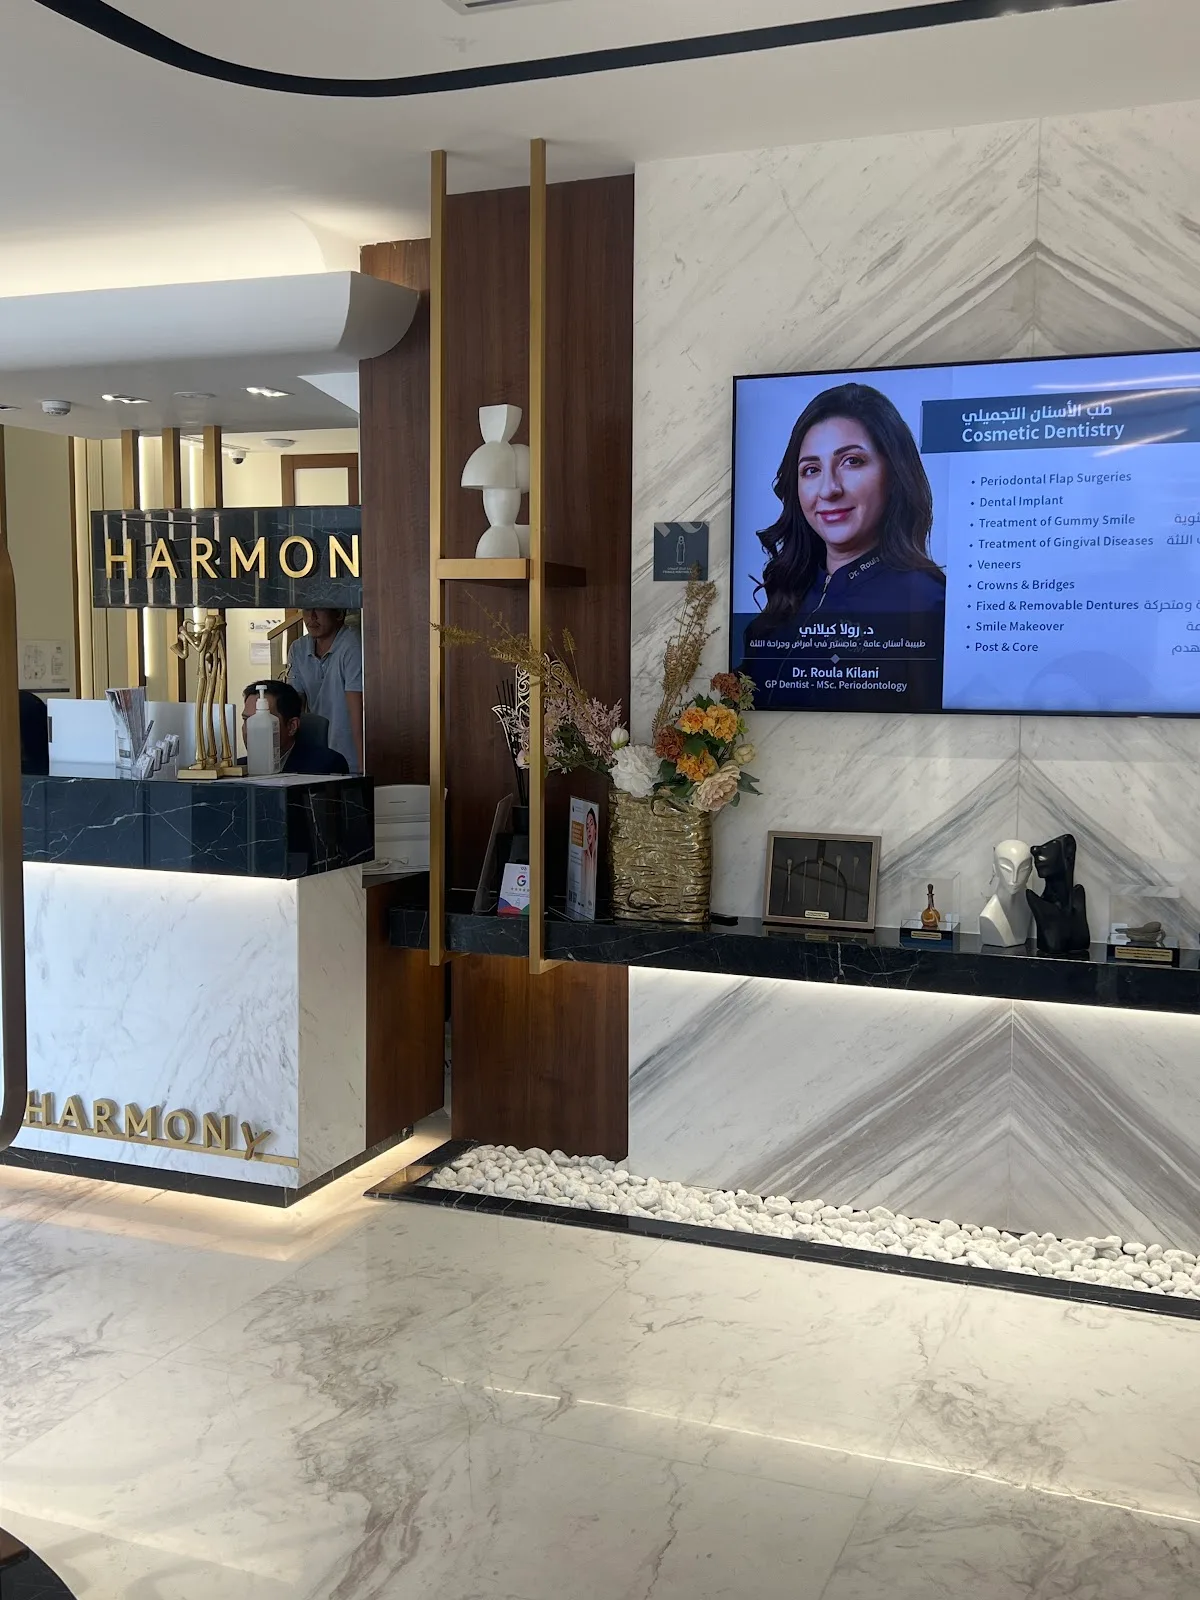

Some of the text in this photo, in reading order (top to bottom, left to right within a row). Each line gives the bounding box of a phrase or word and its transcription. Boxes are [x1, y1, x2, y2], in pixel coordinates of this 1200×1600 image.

[961, 400, 1112, 426] طب الأسنان التجميلي
[962, 422, 1124, 443] Cosmetic Dentistry
[980, 470, 1132, 487] Periodontal Flap Surgeries
[979, 495, 1064, 508] Dental Implant
[979, 514, 1136, 528] Treatment of Gummy Smile
[978, 535, 1154, 550] Treatment of Gingival Diseases
[1166, 534, 1193, 545] اللثة
[104, 534, 361, 579] HARMON
[977, 559, 1021, 570] Veneers
[977, 579, 1075, 592] Crowns & Bridges
[976, 599, 1139, 611] Fixed & Removable Dentures
[1143, 599, 1192, 612] ومتحركة
[799, 623, 837, 638] كيلاني
[840, 623, 860, 638] رولا
[975, 620, 1065, 632] Smile Makeover
[749, 639, 766, 648] اللثة
[767, 639, 790, 650] وجراحة
[791, 638, 813, 649] أمراض
[814, 640, 828, 649] في
[828, 639, 858, 650] ماجستير
[863, 639, 881, 648] عامة
[882, 638, 904, 649] أسنان
[905, 639, 926, 649] طبيبة
[975, 642, 1039, 652] Post & Core
[792, 666, 879, 678] Dr. Roula Kilani
[765, 680, 777, 689] GP
[779, 680, 809, 689] Dentist
[816, 680, 837, 689] MSc.
[838, 680, 908, 693] Periodontology
[25, 1088, 272, 1161] HARMONY
